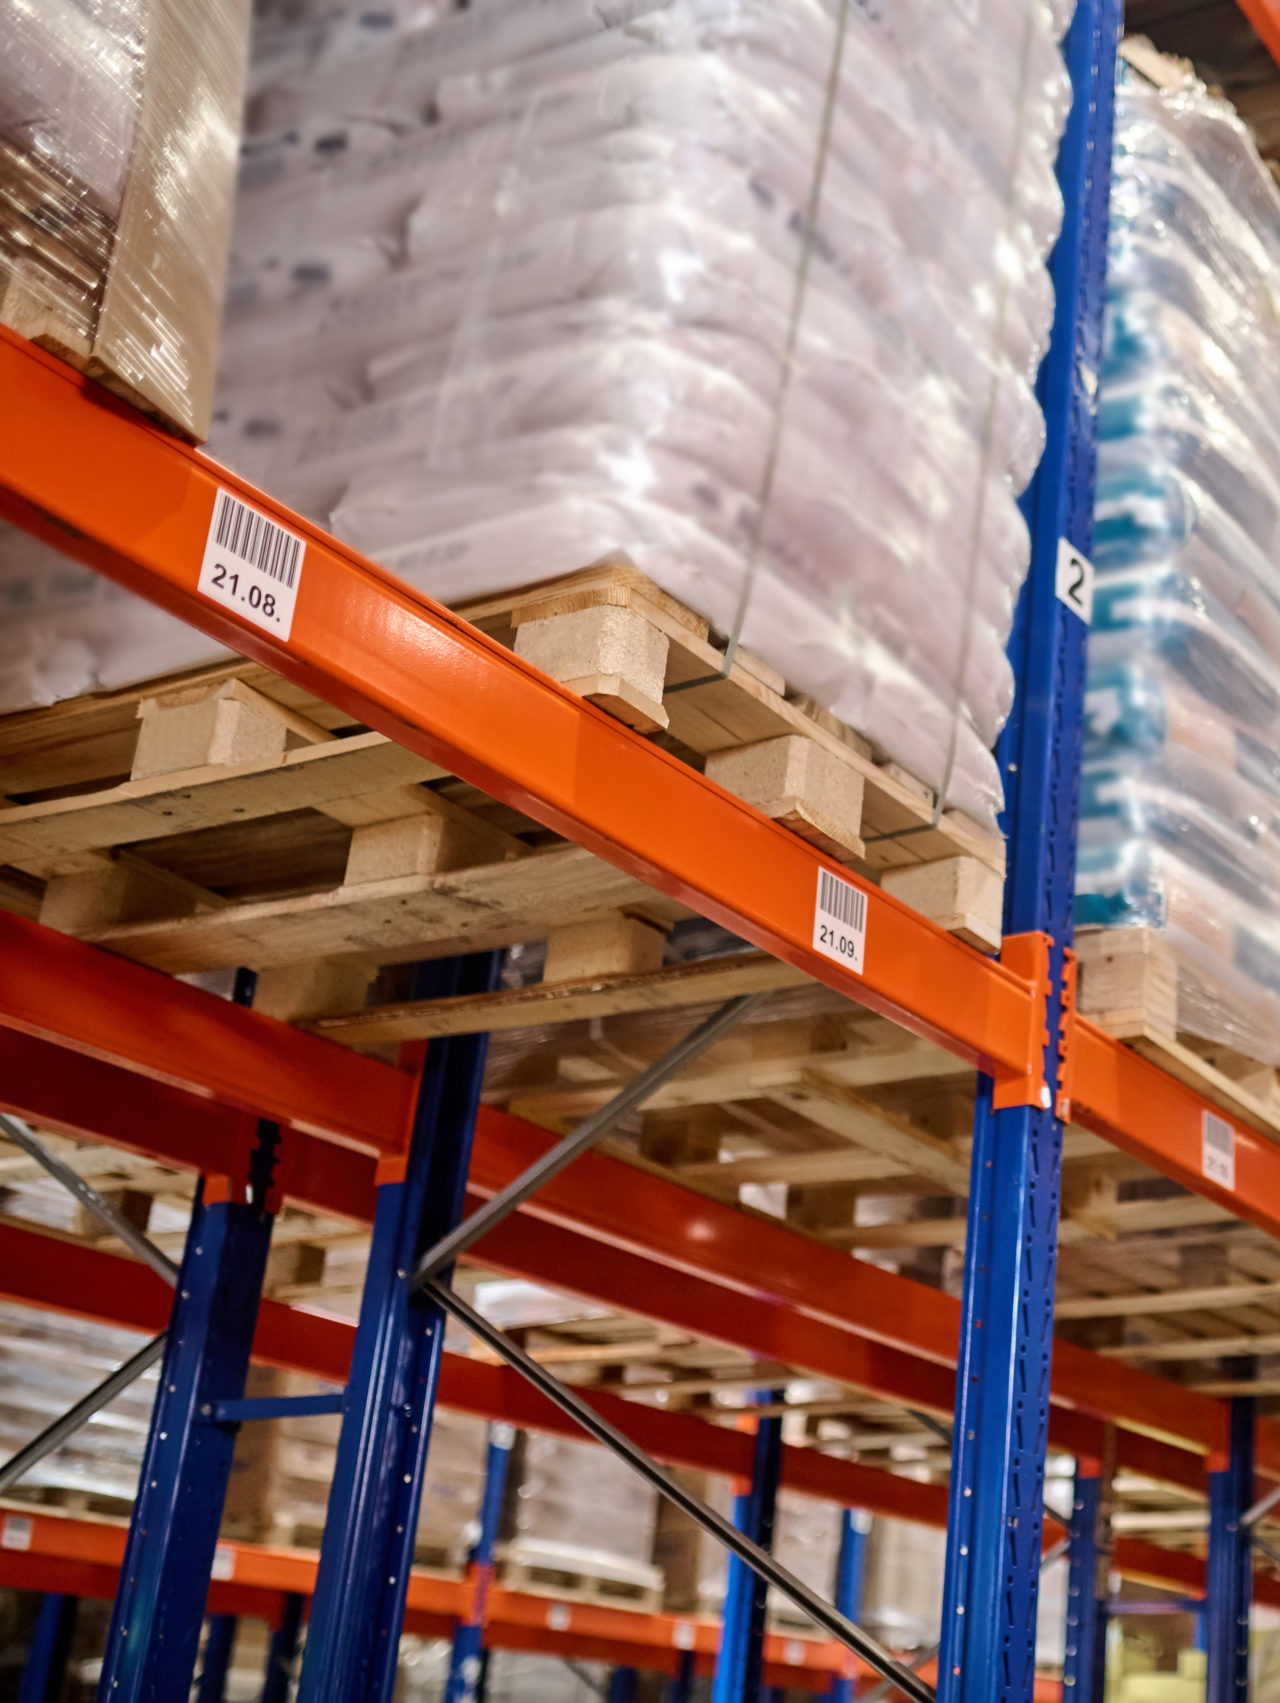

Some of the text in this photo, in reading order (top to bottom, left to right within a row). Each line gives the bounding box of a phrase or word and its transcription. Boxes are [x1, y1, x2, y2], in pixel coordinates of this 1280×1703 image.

[210, 563, 281, 623] 21.08.
[1068, 557, 1085, 606] 2
[819, 924, 858, 961] 21.09.
